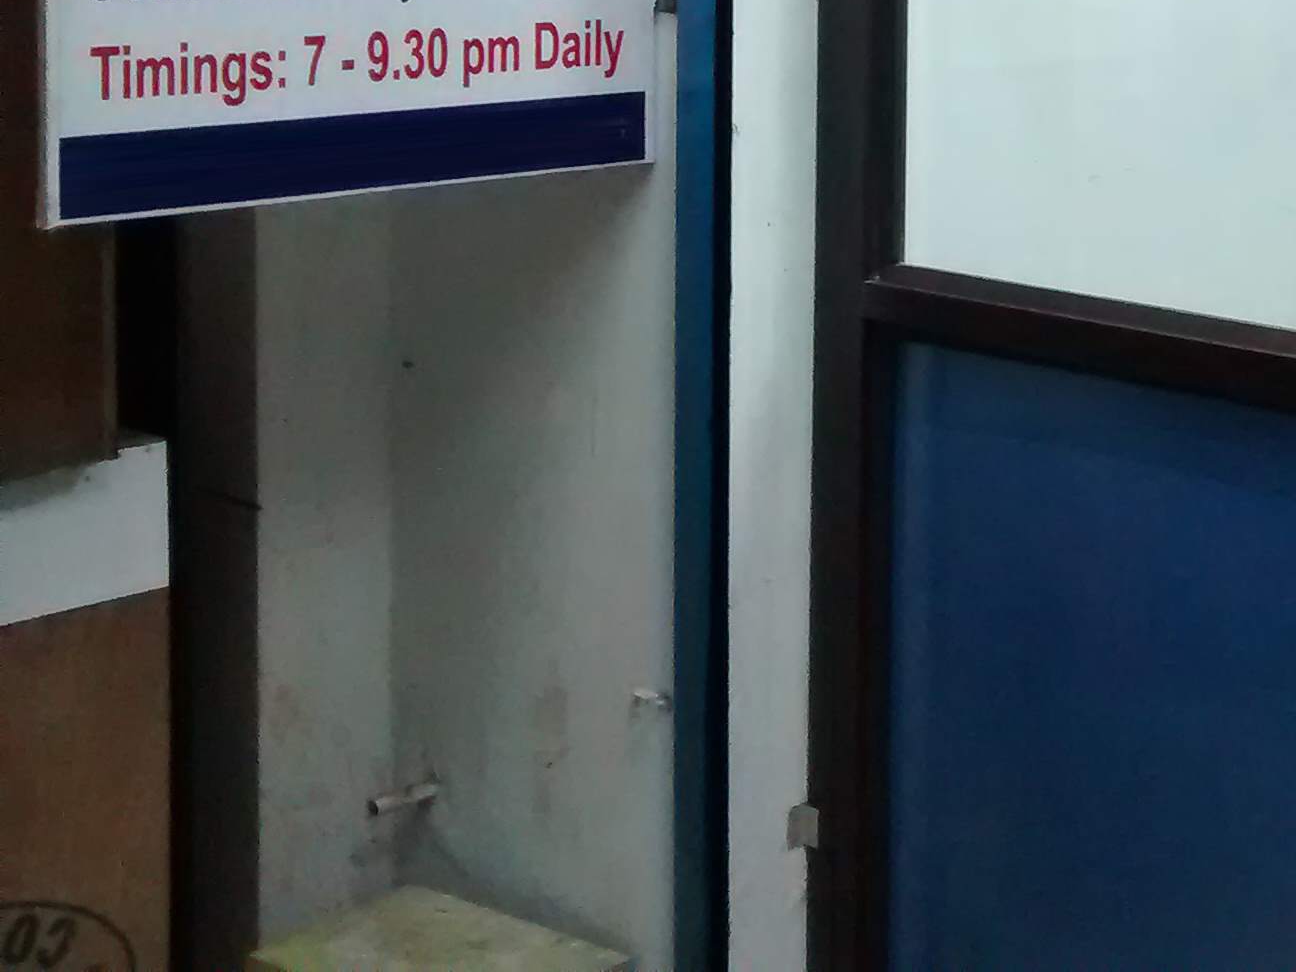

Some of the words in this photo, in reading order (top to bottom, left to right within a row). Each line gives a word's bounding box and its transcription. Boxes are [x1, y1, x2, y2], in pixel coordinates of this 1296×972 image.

[90, 42, 287, 107] Timings:
[304, 35, 326, 86] 7
[368, 28, 448, 82] 9.30
[463, 35, 520, 87] pm
[534, 19, 625, 78] Daily
